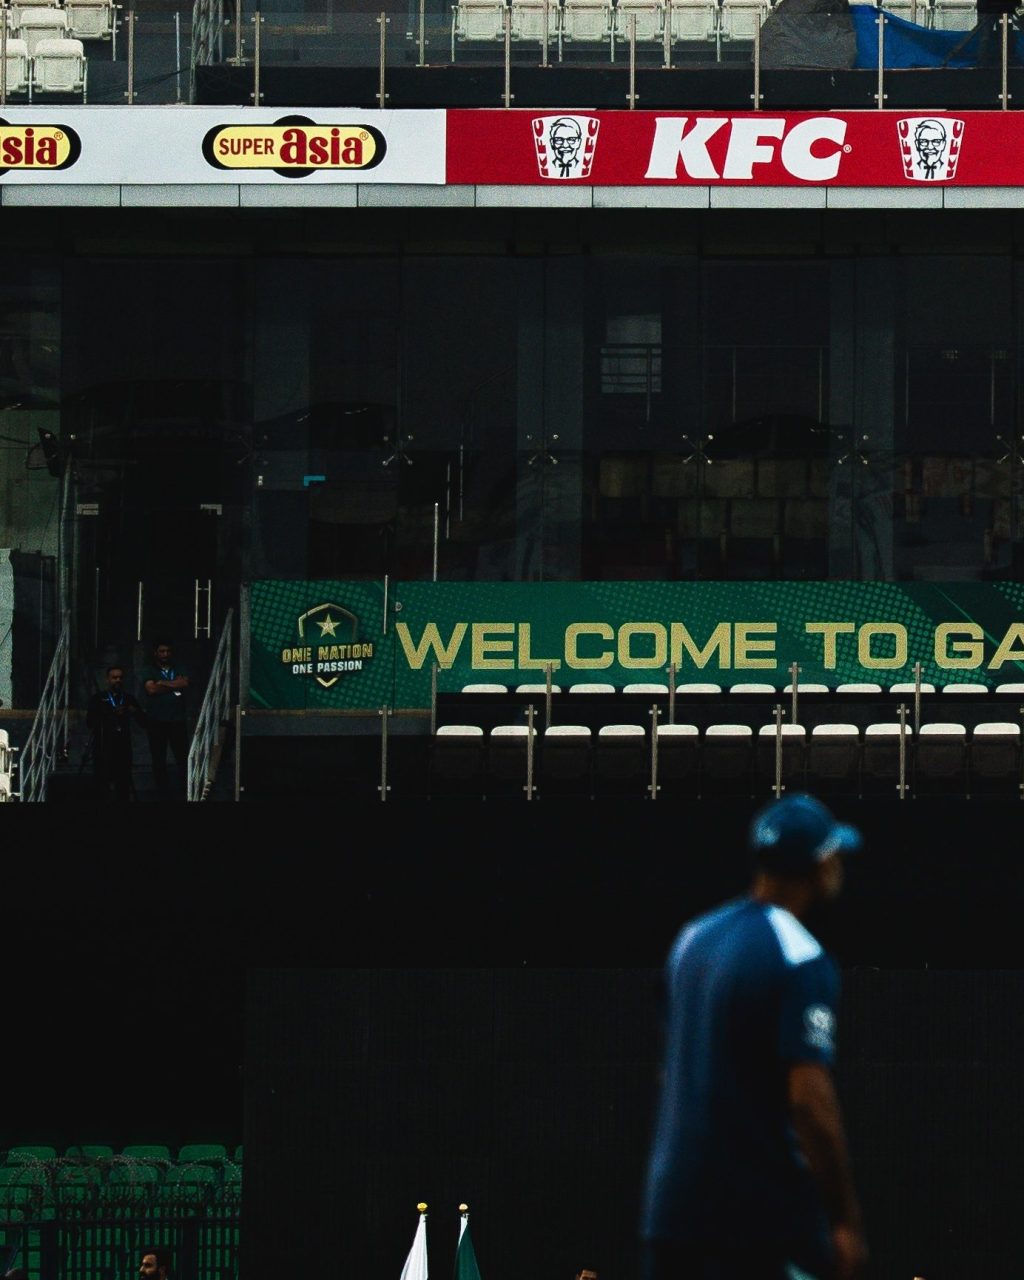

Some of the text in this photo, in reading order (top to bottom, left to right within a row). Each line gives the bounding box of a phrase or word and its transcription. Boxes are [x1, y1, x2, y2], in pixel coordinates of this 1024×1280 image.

[1, 127, 58, 166] sia
[218, 127, 364, 166] SUPER asia
[644, 116, 848, 182] KFC
[282, 643, 373, 663] ONE NATION
[395, 622, 778, 670] WELCOME
[805, 622, 908, 670] TO
[292, 660, 363, 675] ONE PASSION
